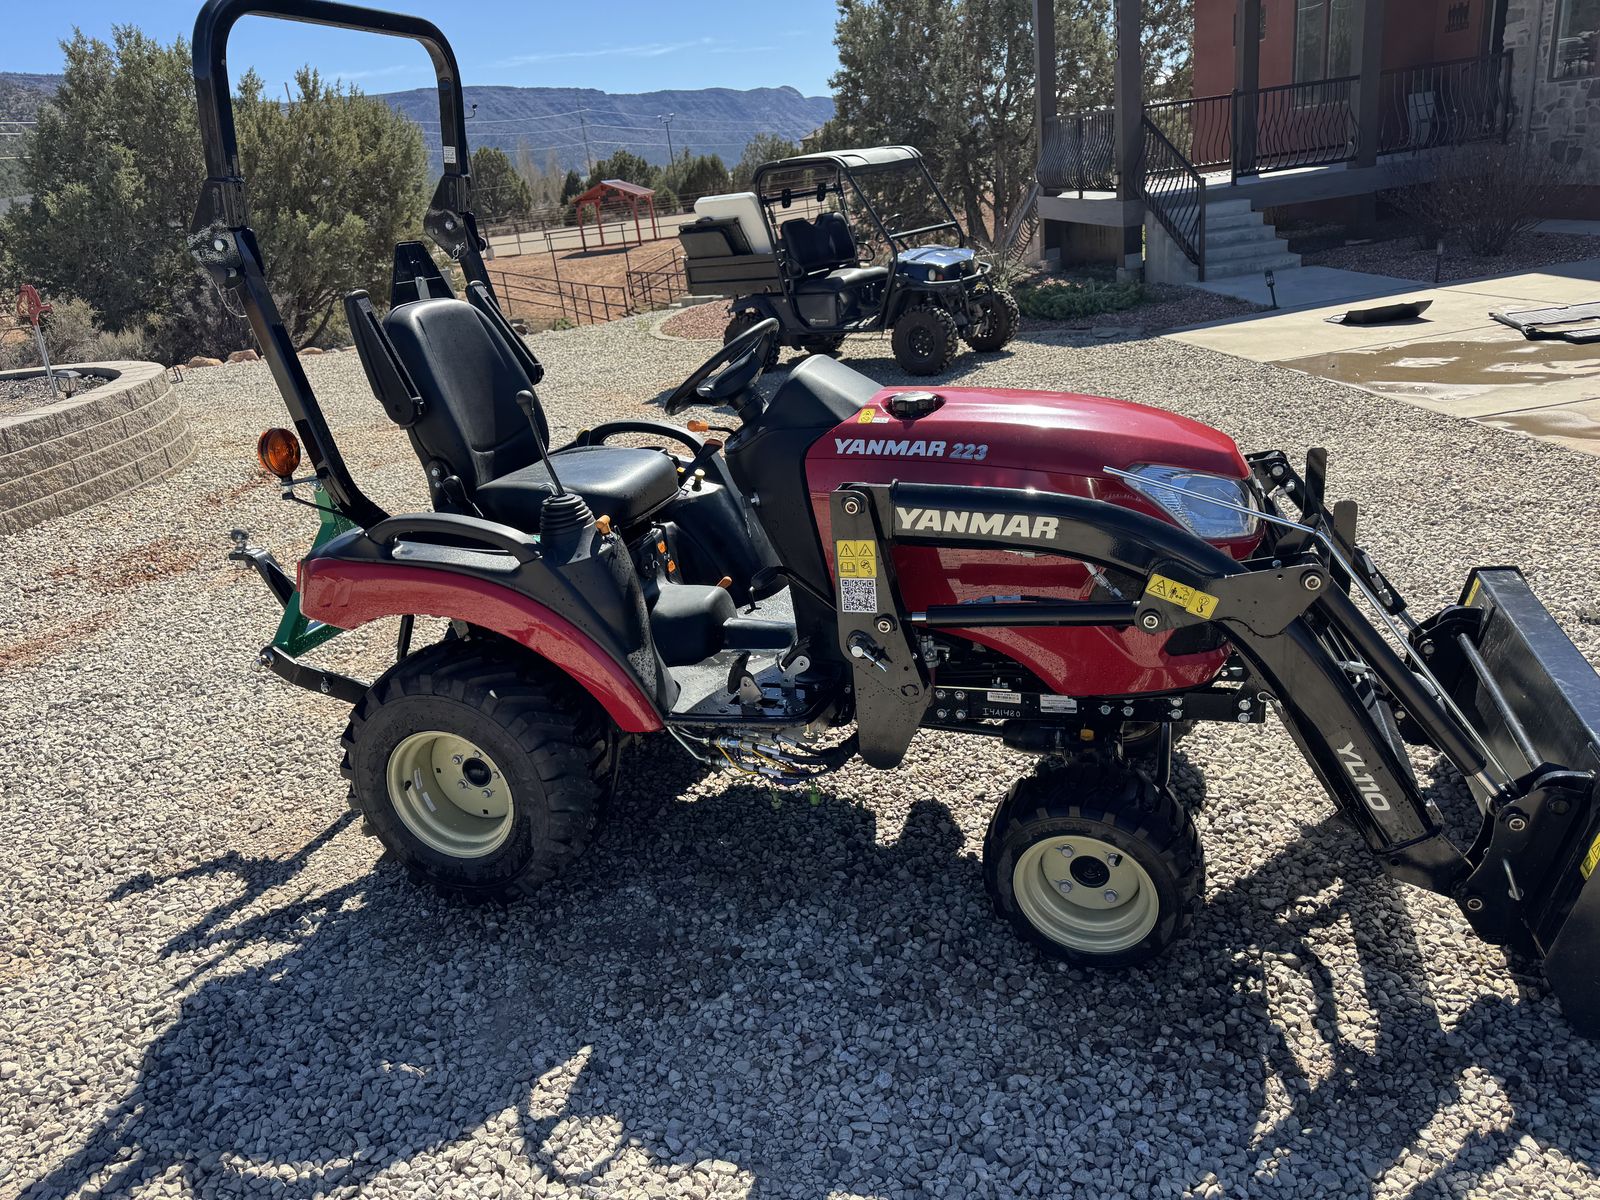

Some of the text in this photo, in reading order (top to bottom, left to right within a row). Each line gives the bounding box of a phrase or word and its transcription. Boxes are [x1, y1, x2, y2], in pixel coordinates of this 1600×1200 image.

[834, 438, 989, 461] YANMAR 223
[896, 507, 1059, 540] YANMAR
[1336, 741, 1391, 811] YL110
